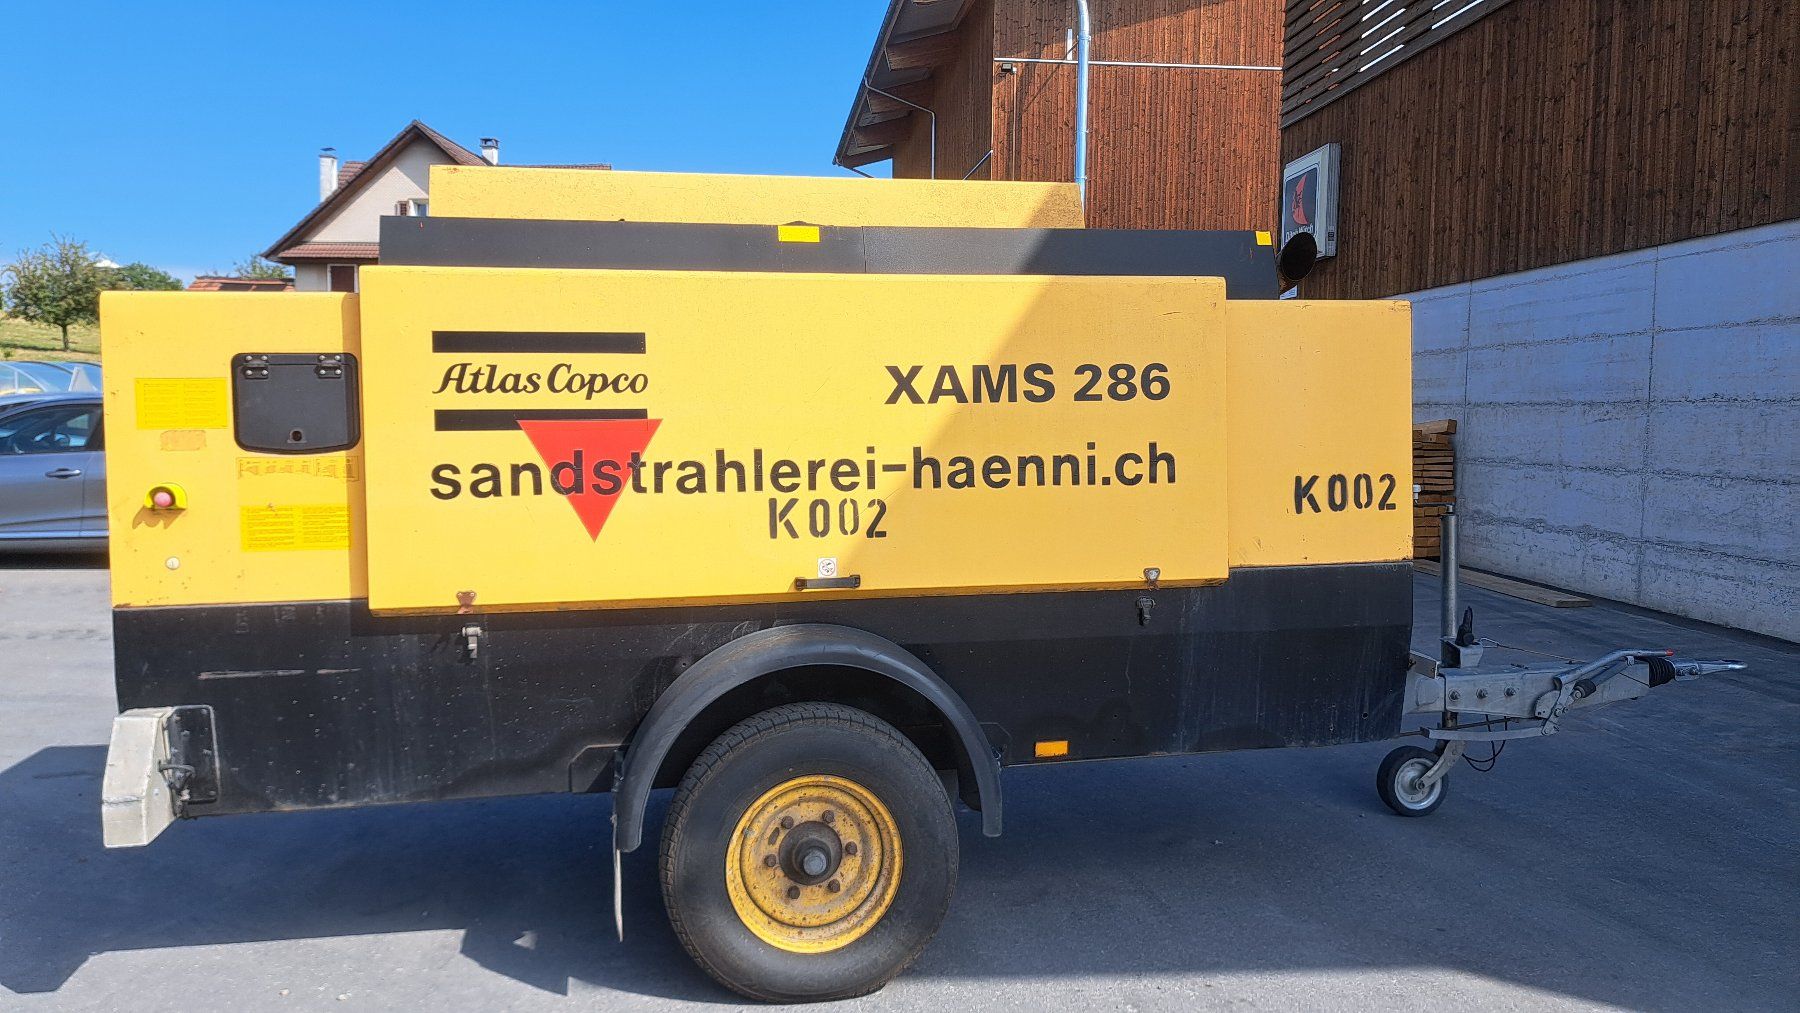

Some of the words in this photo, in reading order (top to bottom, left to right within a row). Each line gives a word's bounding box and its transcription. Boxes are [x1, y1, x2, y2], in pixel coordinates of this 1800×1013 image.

[432, 362, 541, 394] Atlas
[547, 363, 649, 400] Copco
[885, 362, 1056, 404] XAMS
[1074, 362, 1171, 402] 286
[431, 442, 1176, 500] sandstrahlerei-haenni.ch
[1294, 473, 1397, 515] K002
[768, 498, 887, 539] K002
